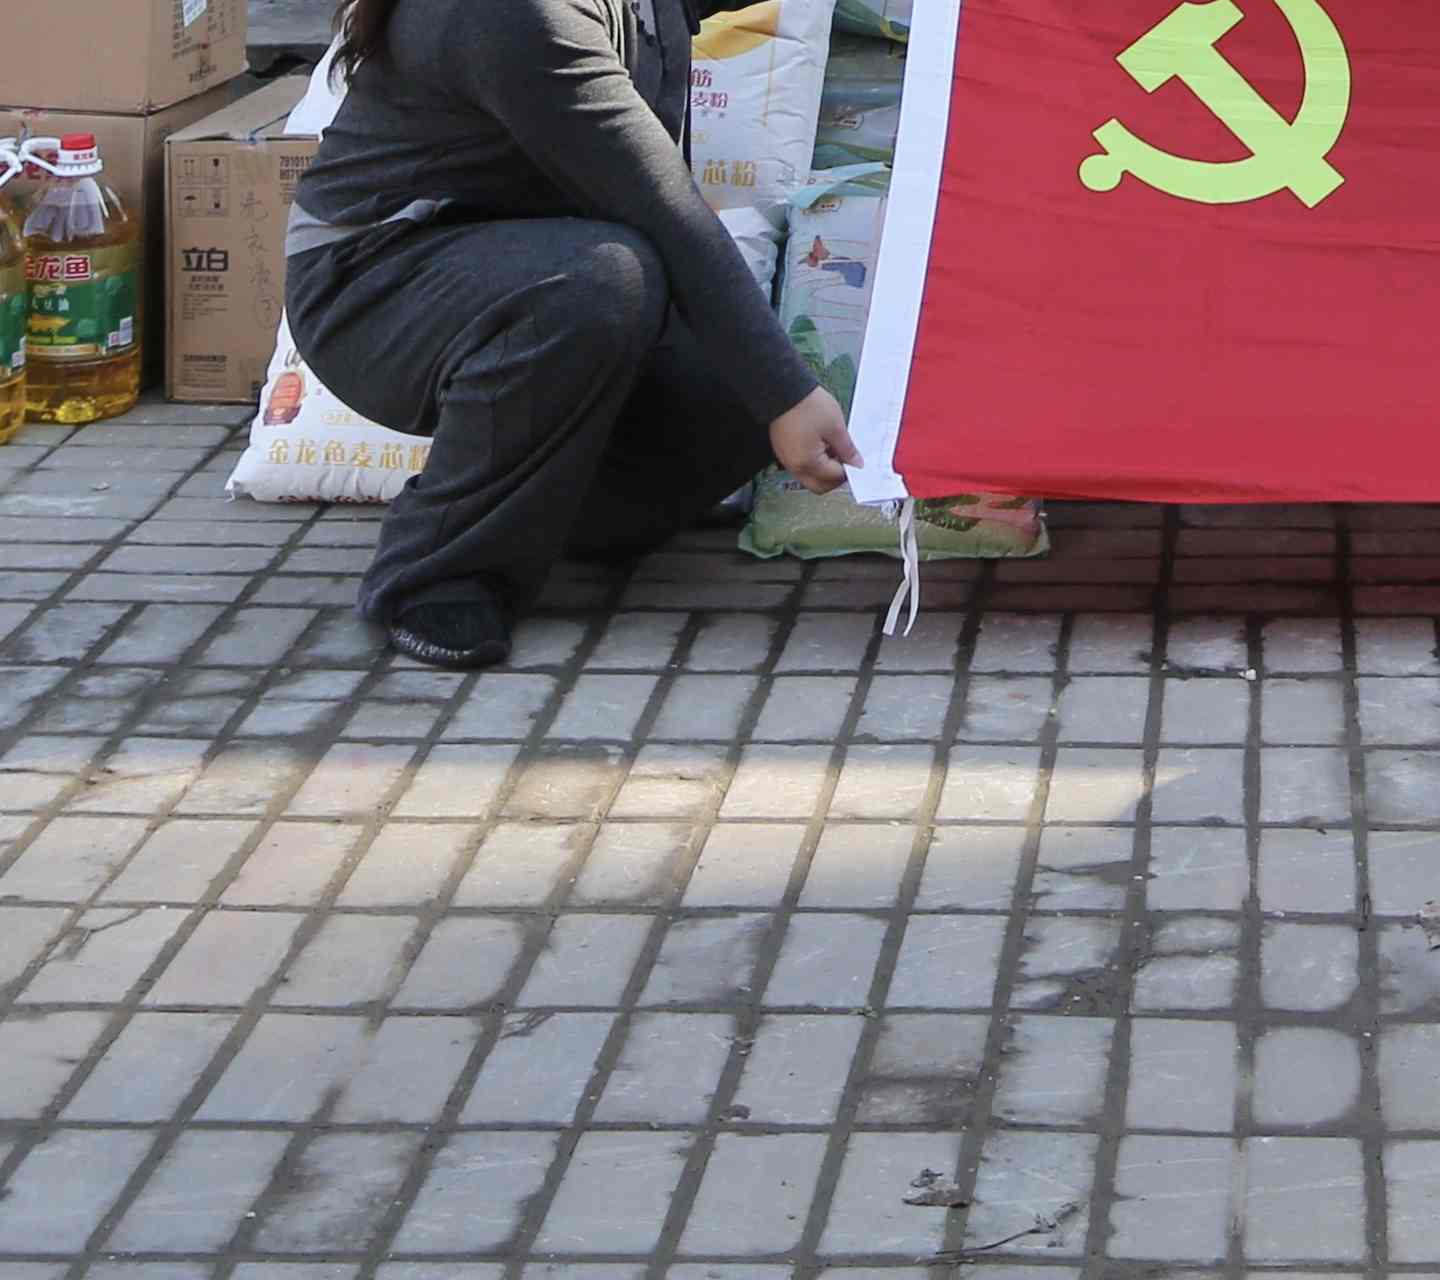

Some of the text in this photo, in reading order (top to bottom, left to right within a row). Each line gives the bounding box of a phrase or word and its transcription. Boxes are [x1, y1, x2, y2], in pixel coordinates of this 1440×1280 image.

[24, 255, 91, 281] 金龙鱼
[181, 247, 229, 272] 立白
